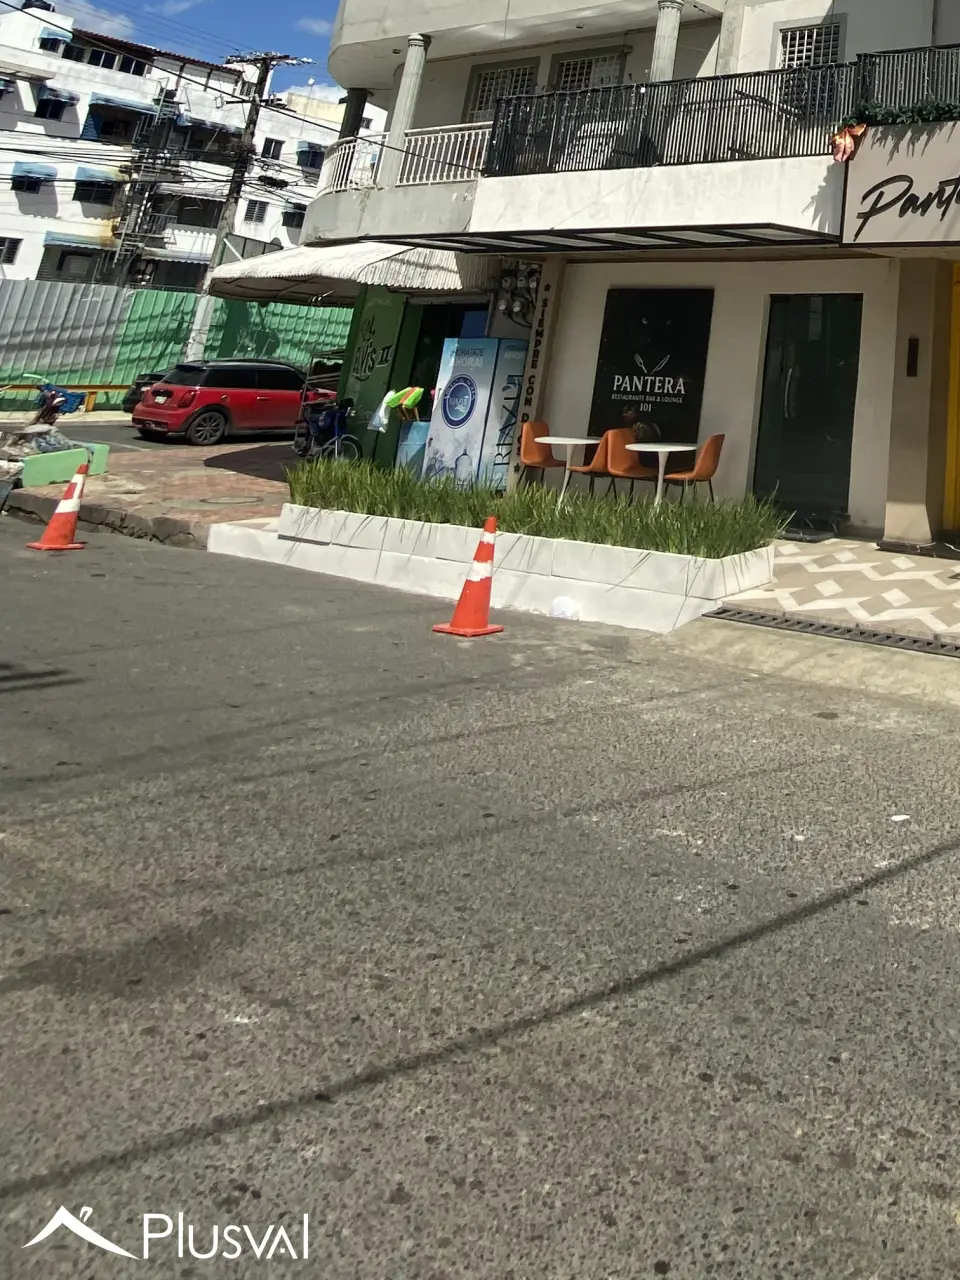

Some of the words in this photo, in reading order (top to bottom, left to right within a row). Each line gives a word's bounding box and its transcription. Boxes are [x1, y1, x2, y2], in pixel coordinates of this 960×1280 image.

[524, 375, 536, 407] CON
[612, 374, 686, 394] PANTERA
[640, 403, 652, 412] 101
